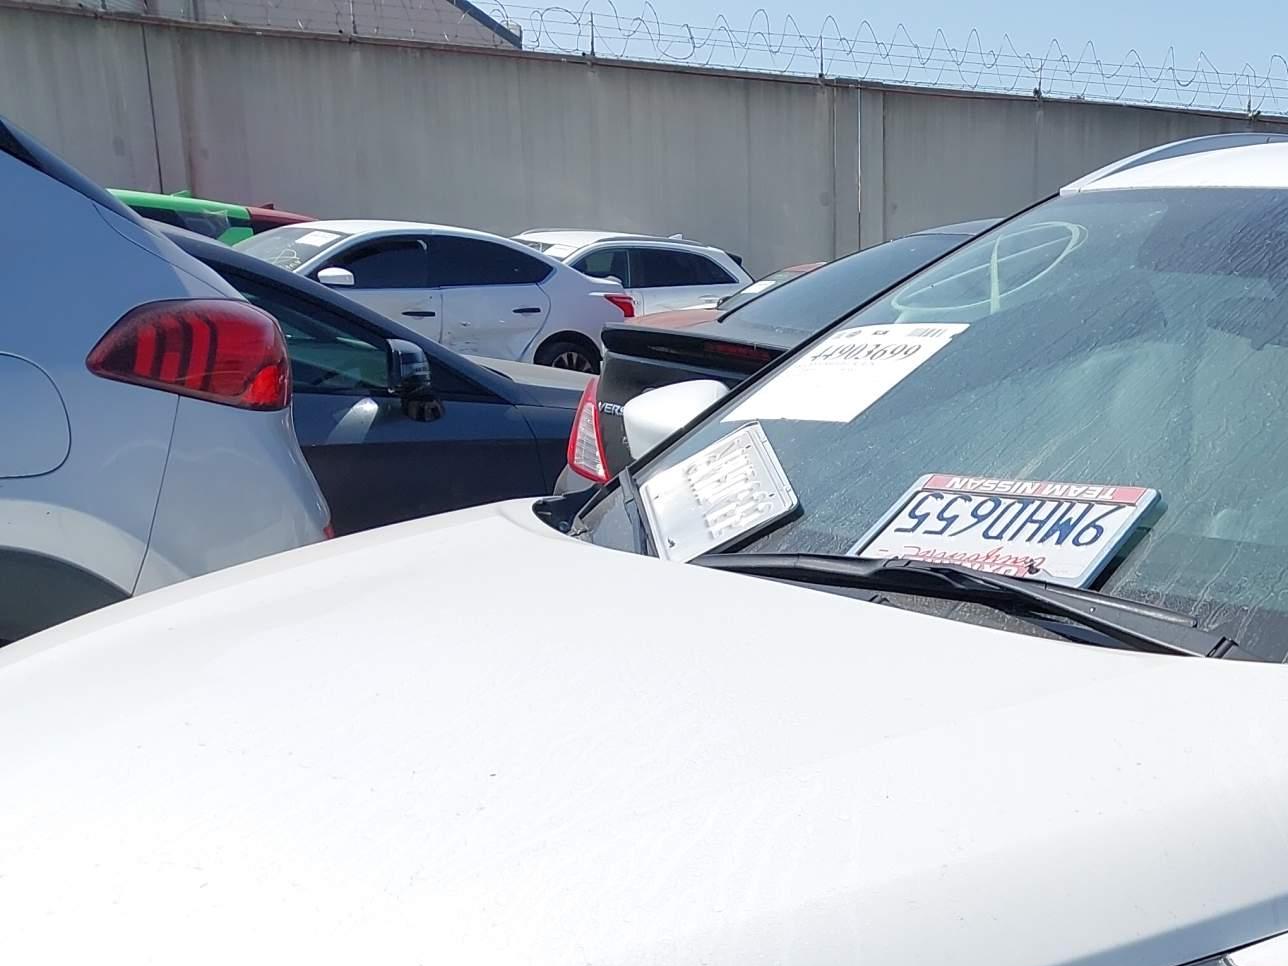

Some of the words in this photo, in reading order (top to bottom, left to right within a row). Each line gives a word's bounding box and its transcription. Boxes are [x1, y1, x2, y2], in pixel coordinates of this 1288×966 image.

[811, 343, 922, 361] 44903699
[598, 402, 625, 416] VERS
[946, 477, 1034, 495] NISSAN
[1037, 483, 1116, 500] TEAM
[894, 493, 1126, 546] 9MHD655
